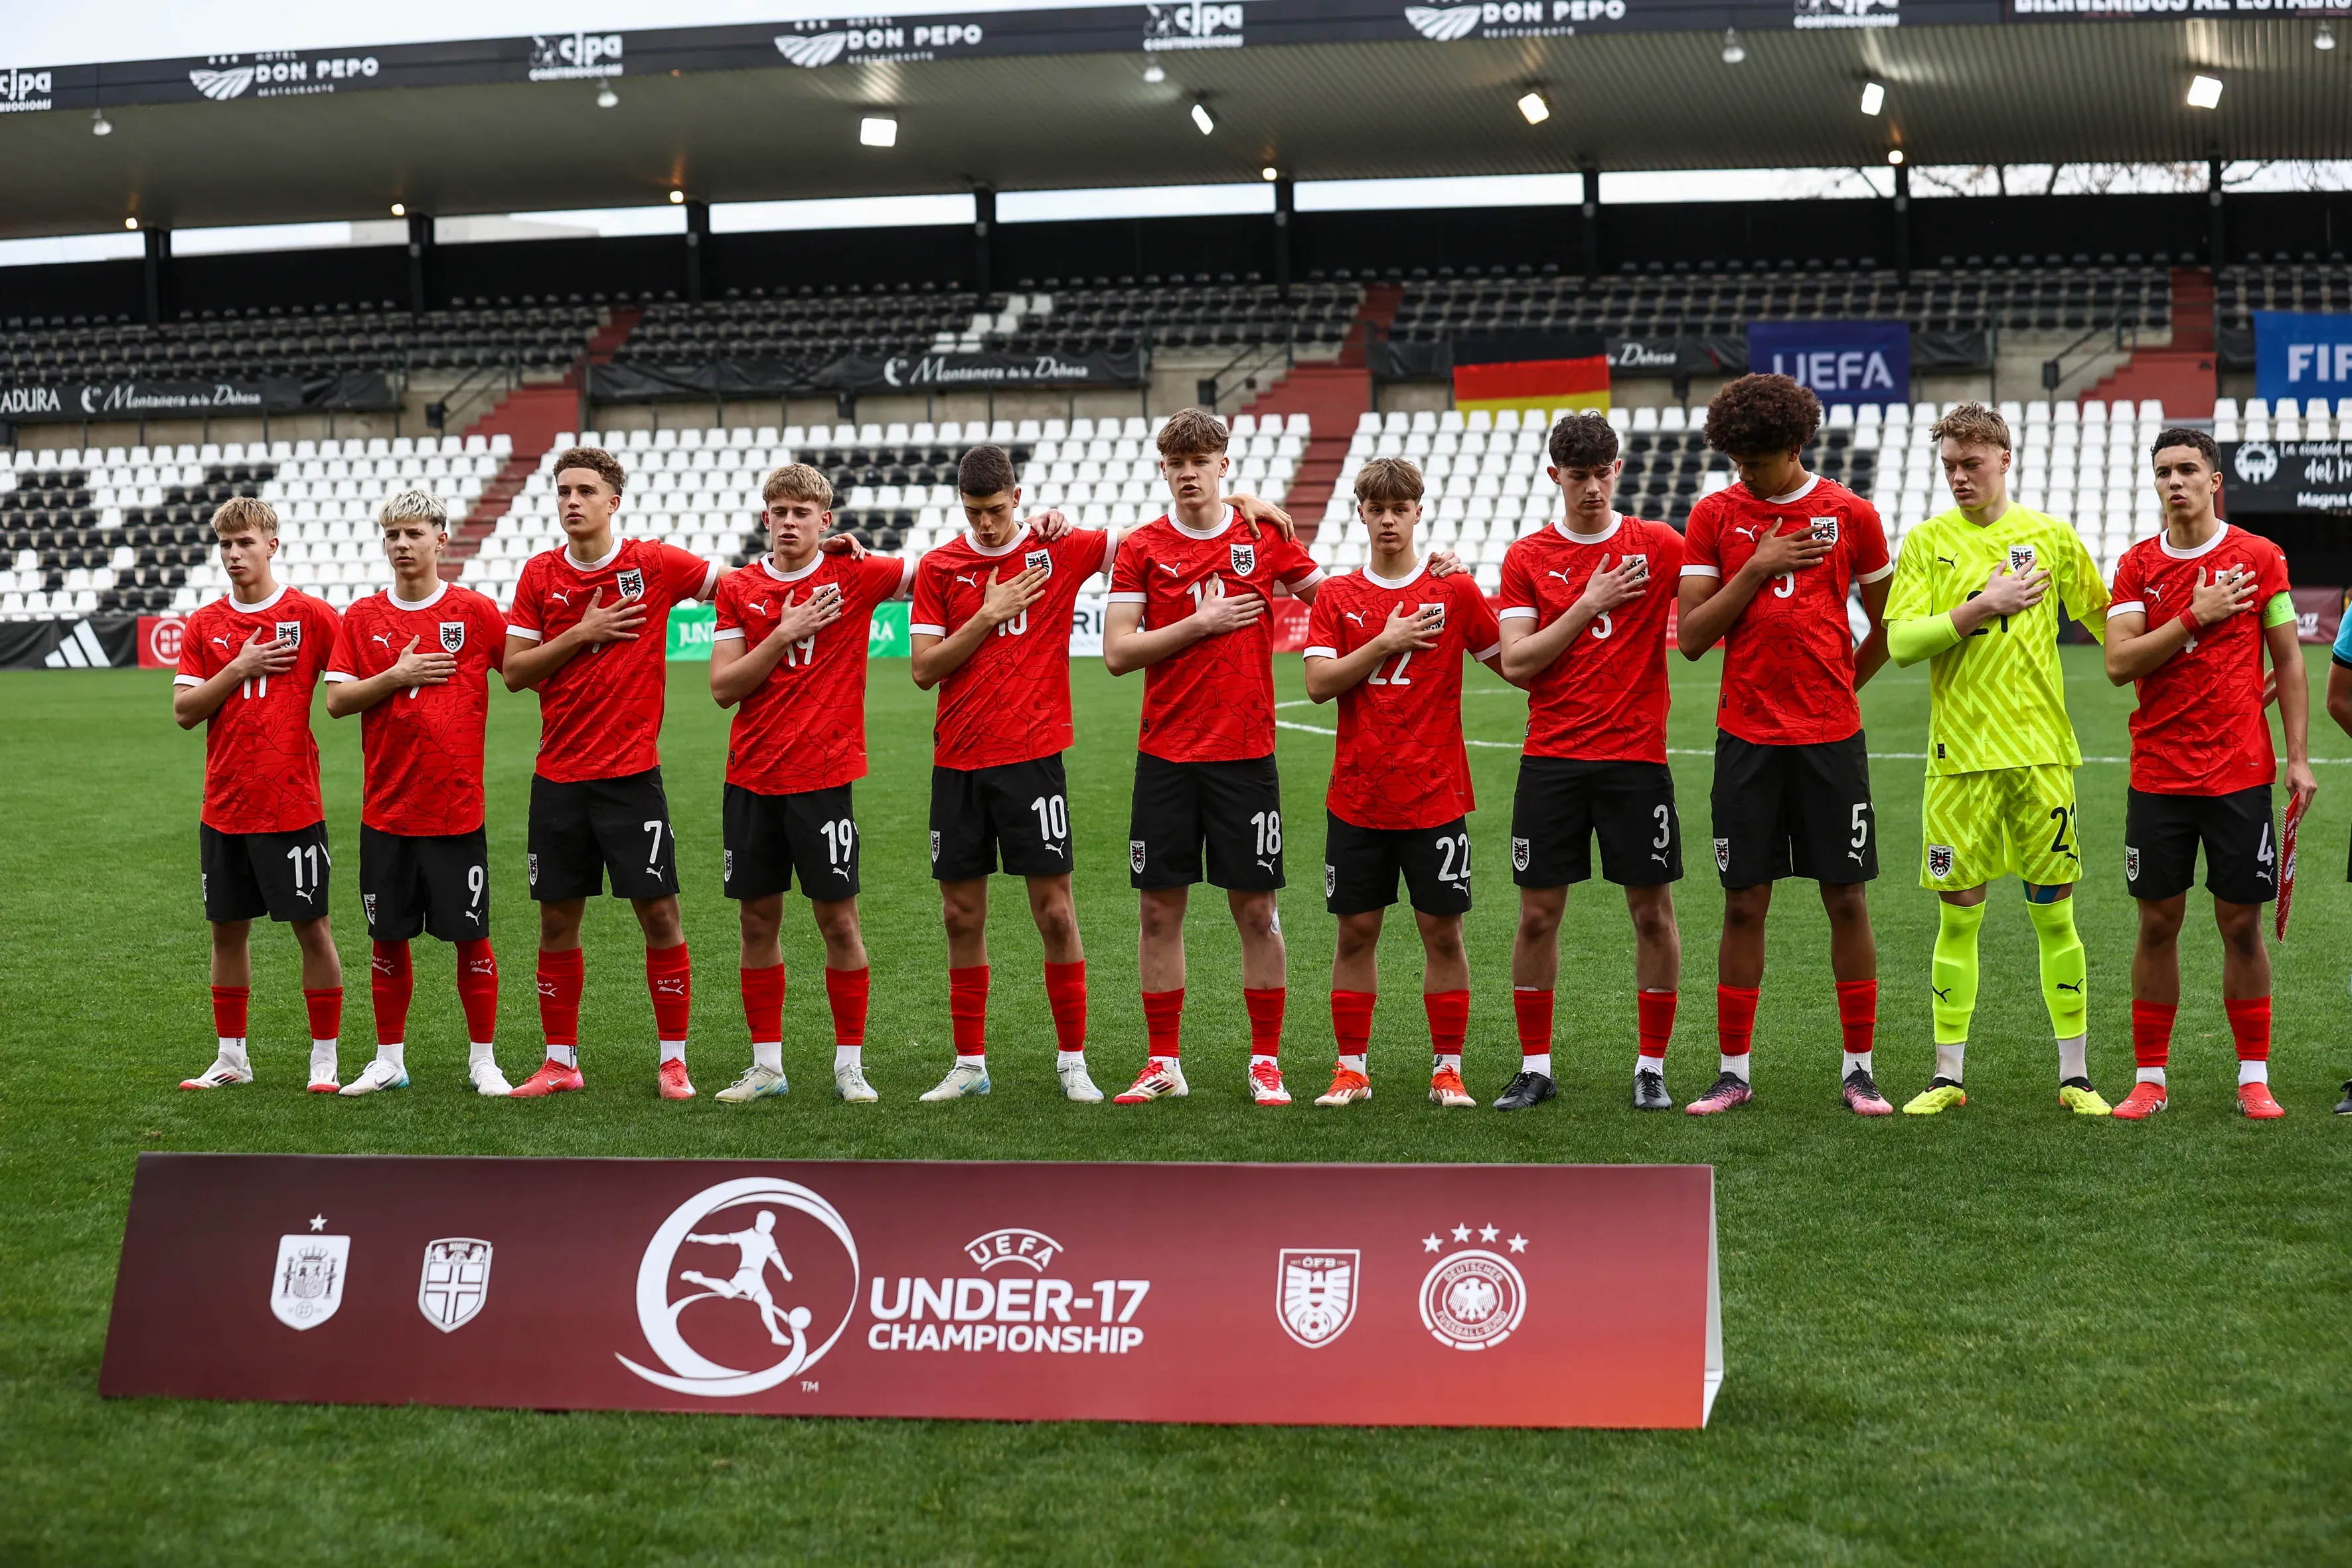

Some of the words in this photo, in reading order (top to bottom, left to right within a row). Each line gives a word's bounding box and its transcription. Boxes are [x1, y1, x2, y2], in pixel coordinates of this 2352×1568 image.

[1482, 1, 1543, 24] DON
[1553, 0, 1626, 21] PEPO
[846, 27, 904, 50] DON
[913, 23, 982, 46] PEPO
[255, 61, 307, 83] DON
[315, 56, 379, 79] PEPO
[909, 356, 1004, 385] Montanera
[1034, 355, 1089, 379] Dehesa
[1619, 342, 1677, 366] Dehesa
[1772, 351, 1895, 390] UEFA
[103, 384, 187, 412] Montanera
[212, 384, 262, 406] Dehesa
[2296, 491, 2347, 510] Magna
[1031, 795, 1067, 841] 10
[1251, 810, 1281, 856] 18
[1652, 804, 1670, 849] 3
[1851, 803, 1867, 848] 5
[644, 820, 663, 864] 7
[821, 818, 853, 864] 19
[1435, 832, 1472, 882] 22
[2257, 822, 2274, 866] 4
[287, 844, 318, 888] 11
[467, 865, 484, 907] 9
[969, 1235, 1053, 1268] UEFA
[1443, 1262, 1504, 1283] DEUTSCHER
[869, 1276, 1150, 1323] UNDER-17
[867, 1323, 1144, 1354] CHAMPIONSHIP
[801, 1380, 819, 1393] TM
